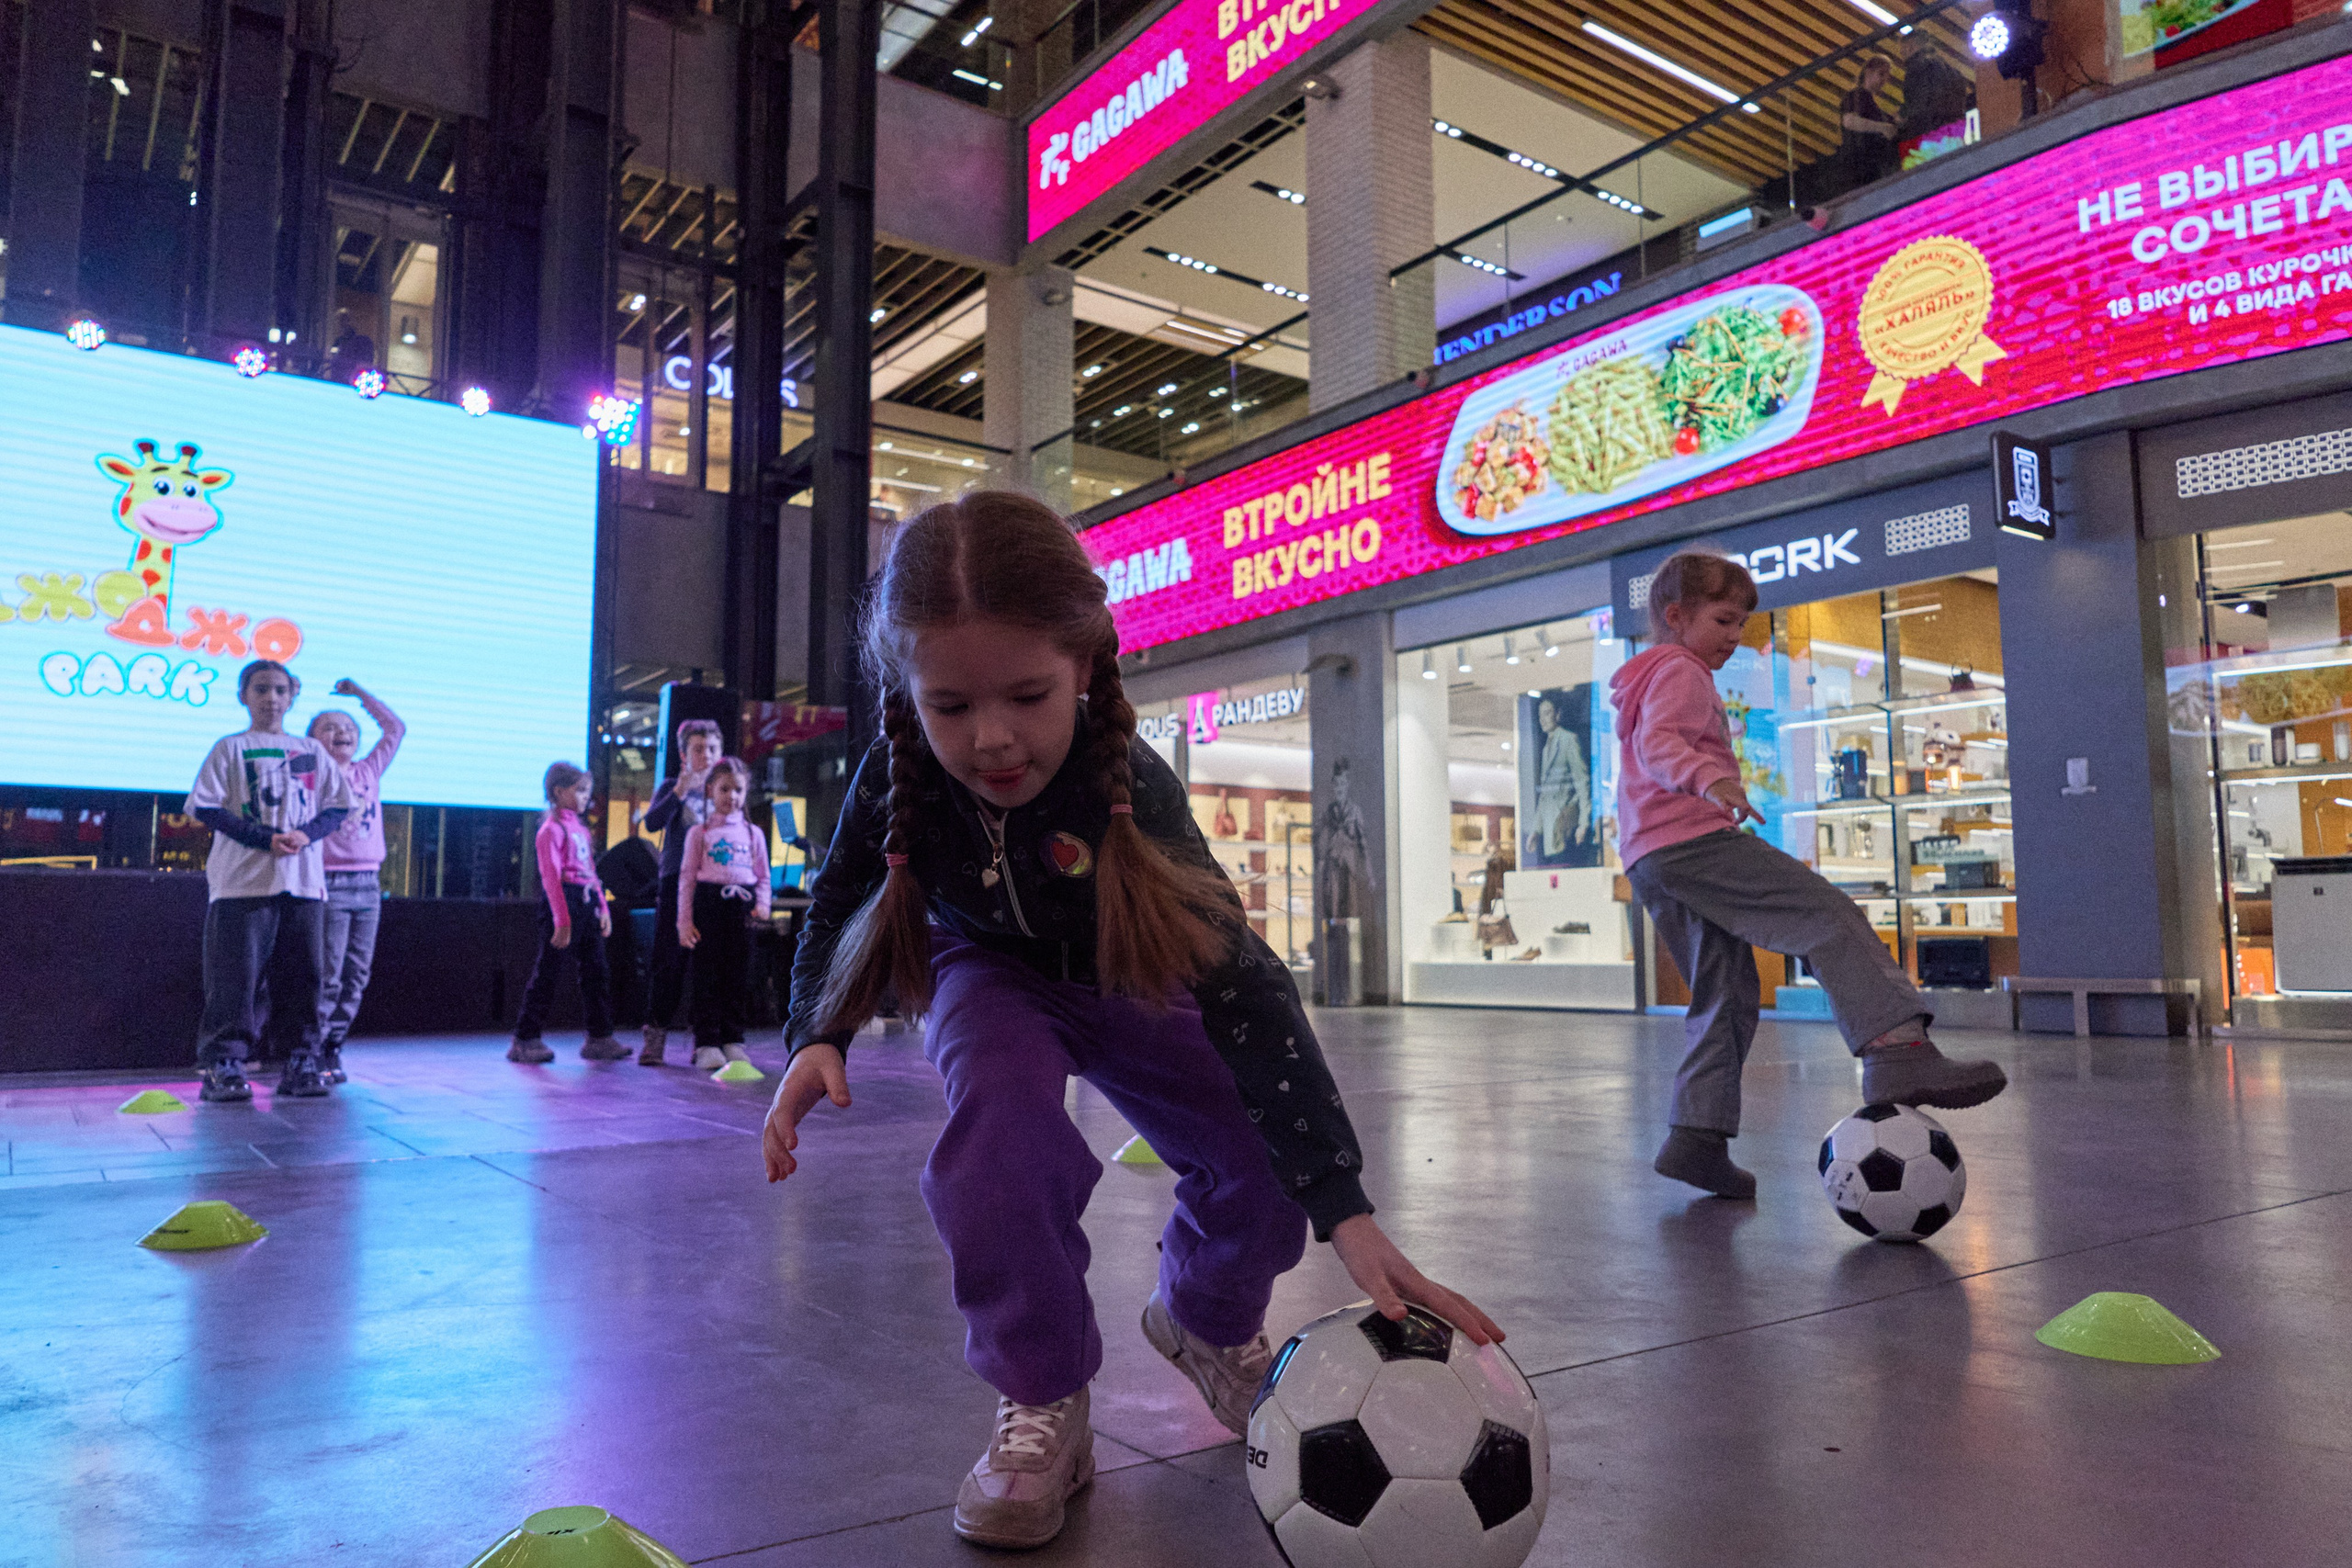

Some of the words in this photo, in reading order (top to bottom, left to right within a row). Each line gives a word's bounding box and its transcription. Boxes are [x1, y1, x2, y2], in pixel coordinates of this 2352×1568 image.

[1071, 48, 1189, 163] GAGAWA
[2077, 181, 2144, 233] НЕ
[2131, 177, 2352, 264] СОЧЕТА
[2107, 296, 2133, 320] 18
[2138, 272, 2242, 312] ВКУСОВ
[2188, 303, 2208, 325] И
[2214, 299, 2232, 318] 4
[2235, 279, 2314, 314] ВИДА
[1223, 452, 1393, 549] ВТРОЙНЕ
[1232, 517, 1382, 600] ВКУСНО
[39, 650, 220, 707] PARK
[1212, 686, 1306, 728] РАНДЕВУ
